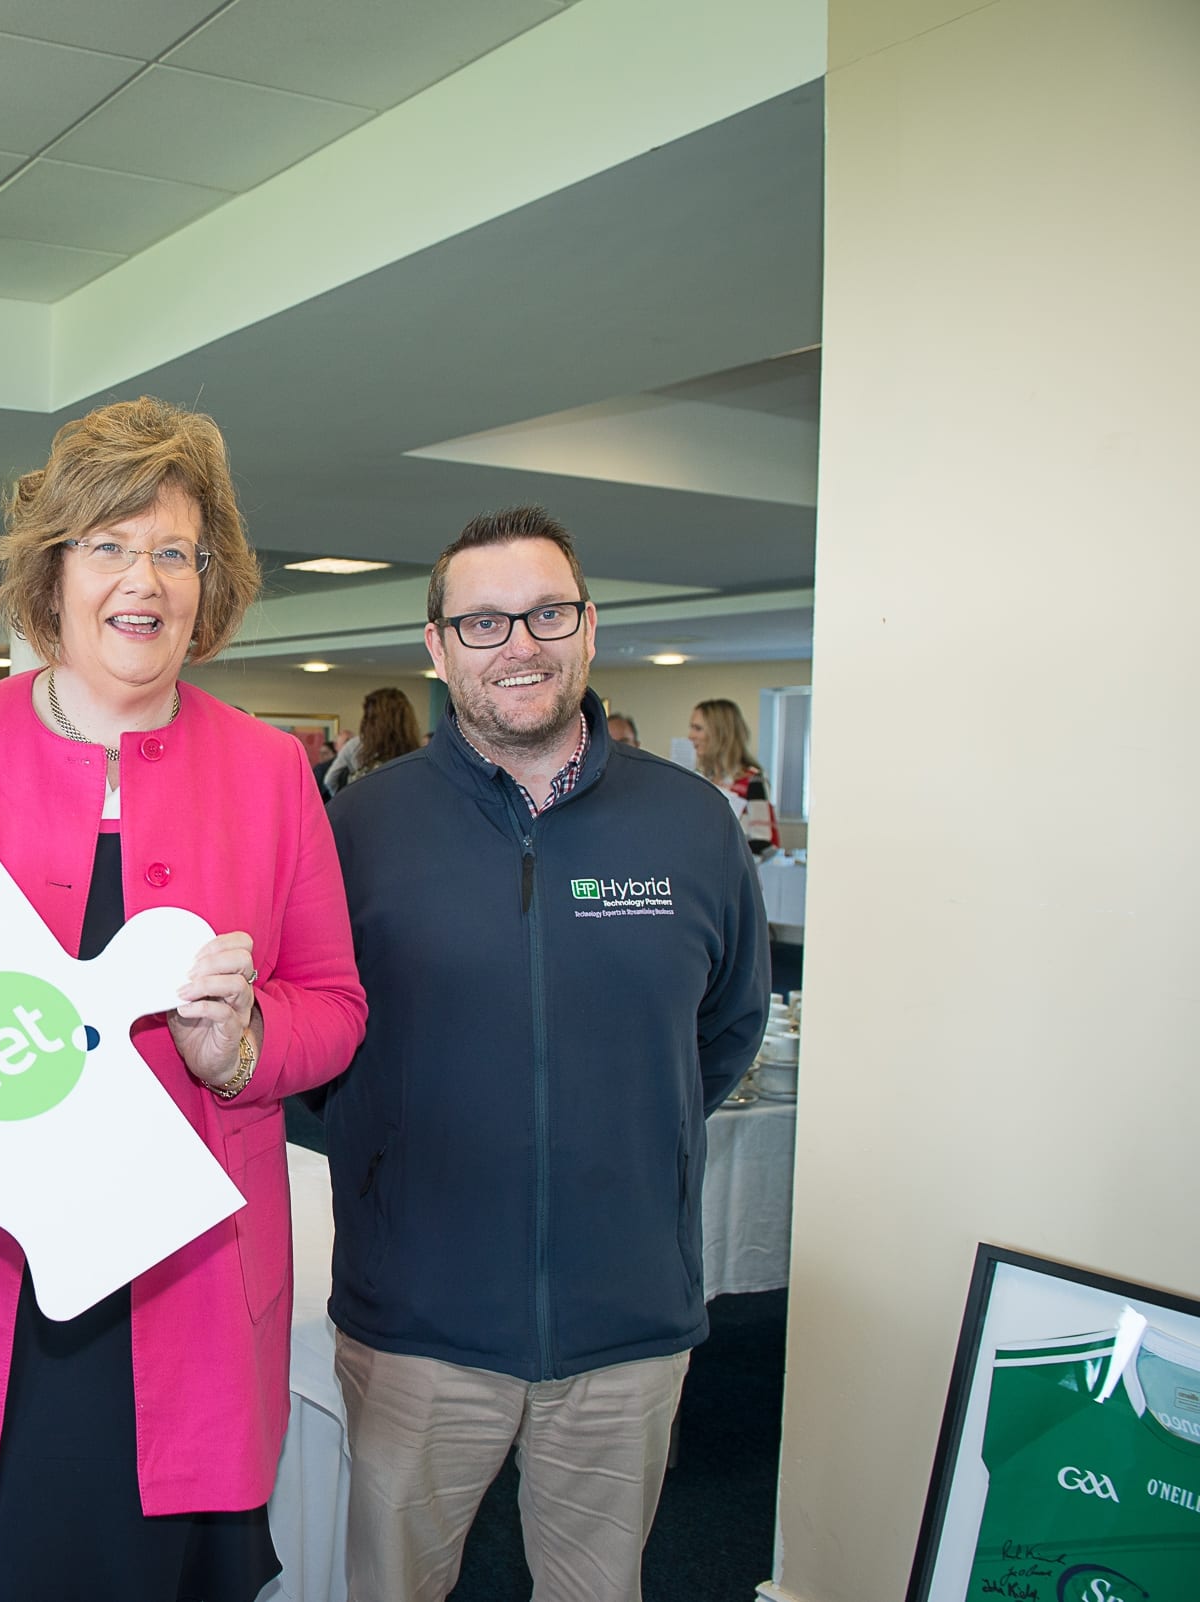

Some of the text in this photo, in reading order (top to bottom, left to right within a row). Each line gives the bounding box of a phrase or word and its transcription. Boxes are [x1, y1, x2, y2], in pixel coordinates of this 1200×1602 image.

[600, 877, 672, 900] Hybrid
[603, 897, 673, 908] Technology Partners
